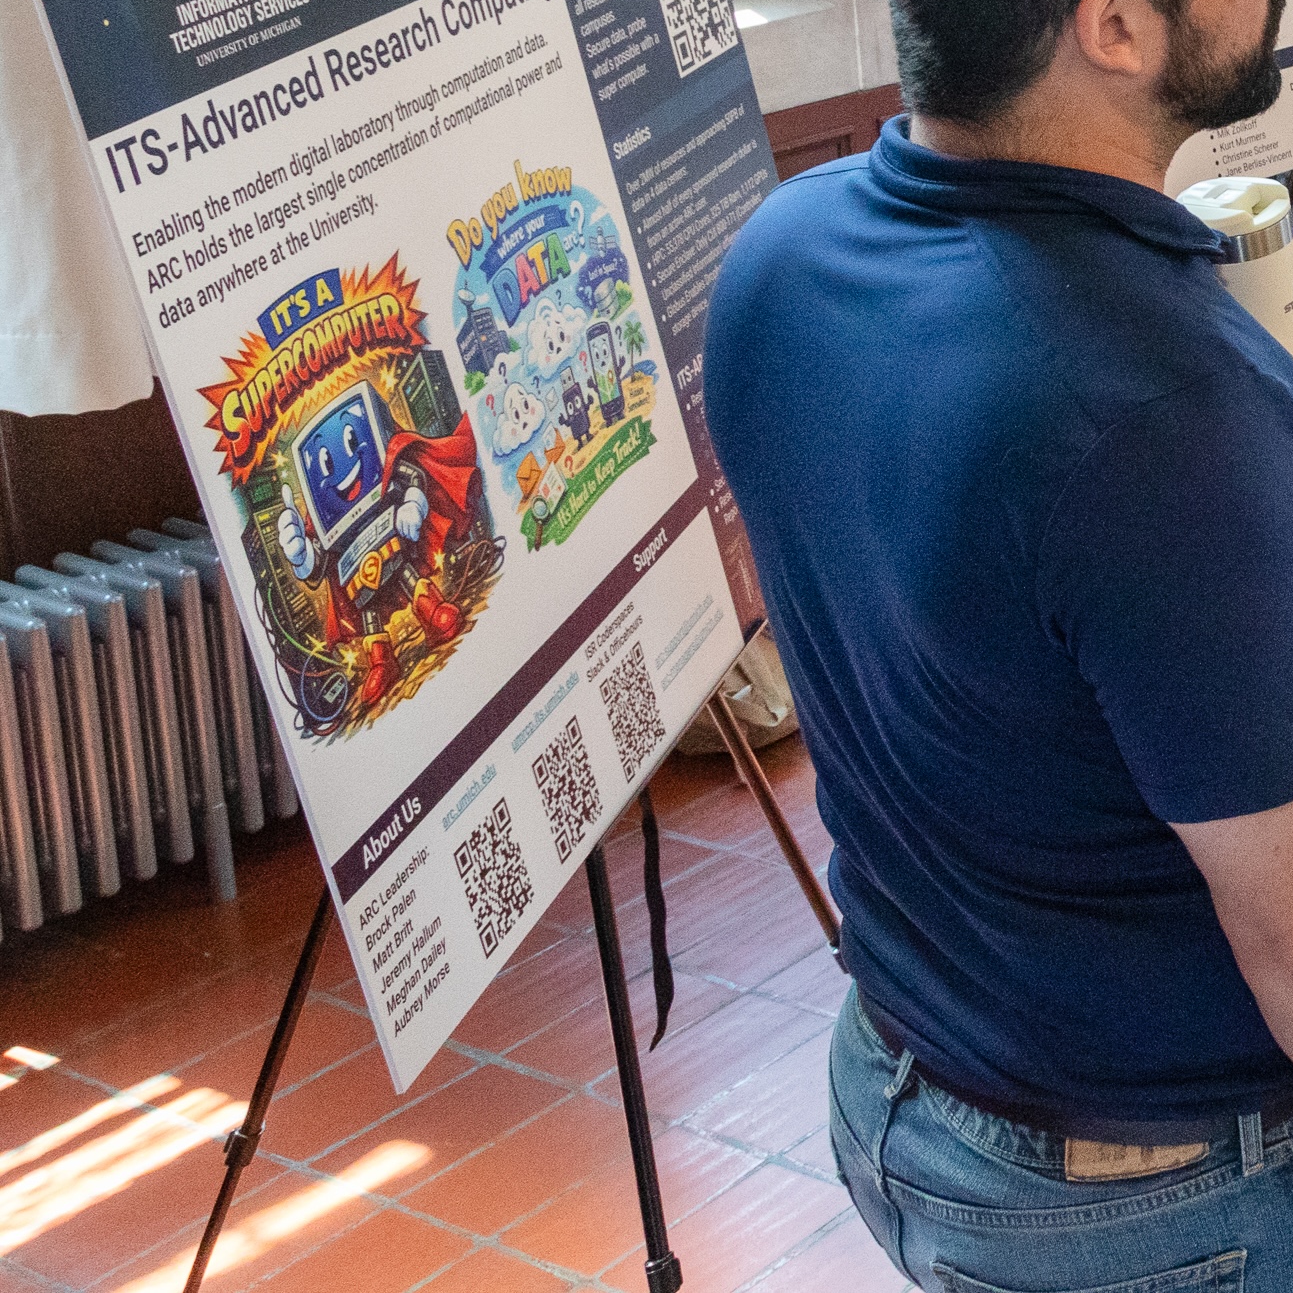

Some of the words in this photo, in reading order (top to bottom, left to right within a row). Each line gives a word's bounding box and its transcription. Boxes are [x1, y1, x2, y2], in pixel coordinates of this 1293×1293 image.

[168, 4, 254, 54] TECHNOLOGY
[195, 36, 248, 67] UNIVERSITY
[247, 32, 260, 46] OF
[258, 15, 302, 42] MICHIGAN
[104, 54, 325, 194] ITS-Advanced
[322, 6, 441, 92] Research
[131, 208, 206, 258] Enabling
[203, 194, 232, 221] the
[231, 165, 289, 207] modern
[288, 137, 332, 178] digital
[329, 110, 395, 155] laboratory
[394, 83, 441, 122] through
[440, 54, 505, 99] computation
[504, 39, 524, 65] and
[523, 33, 548, 55] data.
[146, 255, 183, 295] ARC
[181, 234, 229, 273] holds
[227, 222, 255, 248] the
[252, 191, 306, 234] largest
[305, 170, 347, 207] single
[347, 128, 429, 184] concentration
[428, 114, 442, 139] of
[442, 76, 516, 132] computational
[514, 64, 544, 97] power
[544, 50, 563, 76] and
[612, 125, 652, 160] Statistics
[447, 218, 483, 270] Do
[481, 182, 519, 240] you
[514, 159, 572, 204] know
[497, 225, 524, 259] where
[525, 214, 545, 239] your
[158, 296, 196, 329] data
[196, 254, 269, 308] anywhere
[269, 241, 287, 266] at
[284, 230, 310, 256] the
[308, 193, 379, 242] University.
[492, 232, 571, 328] DATA
[269, 288, 311, 336] IT'S
[315, 278, 334, 306] A
[222, 293, 407, 466] SUPERCOMPUTER
[568, 487, 590, 517] Hard
[588, 479, 597, 494] to
[594, 458, 615, 485] Keep
[613, 422, 641, 461] Track!
[632, 526, 668, 573] Support
[362, 812, 404, 870] About
[400, 796, 422, 824] Us
[358, 898, 380, 931] ARC
[378, 848, 430, 907] Leadership:
[364, 914, 392, 953] Brock
[390, 888, 417, 923] Palen
[371, 940, 395, 974] Matt
[392, 918, 414, 949] Britt
[380, 949, 412, 995] Jeremy
[410, 915, 442, 957] Hallum
[385, 968, 422, 1017] Meghan
[420, 937, 446, 974] Dailey
[393, 993, 424, 1038] Aubrey
[422, 961, 451, 1000] Morse
